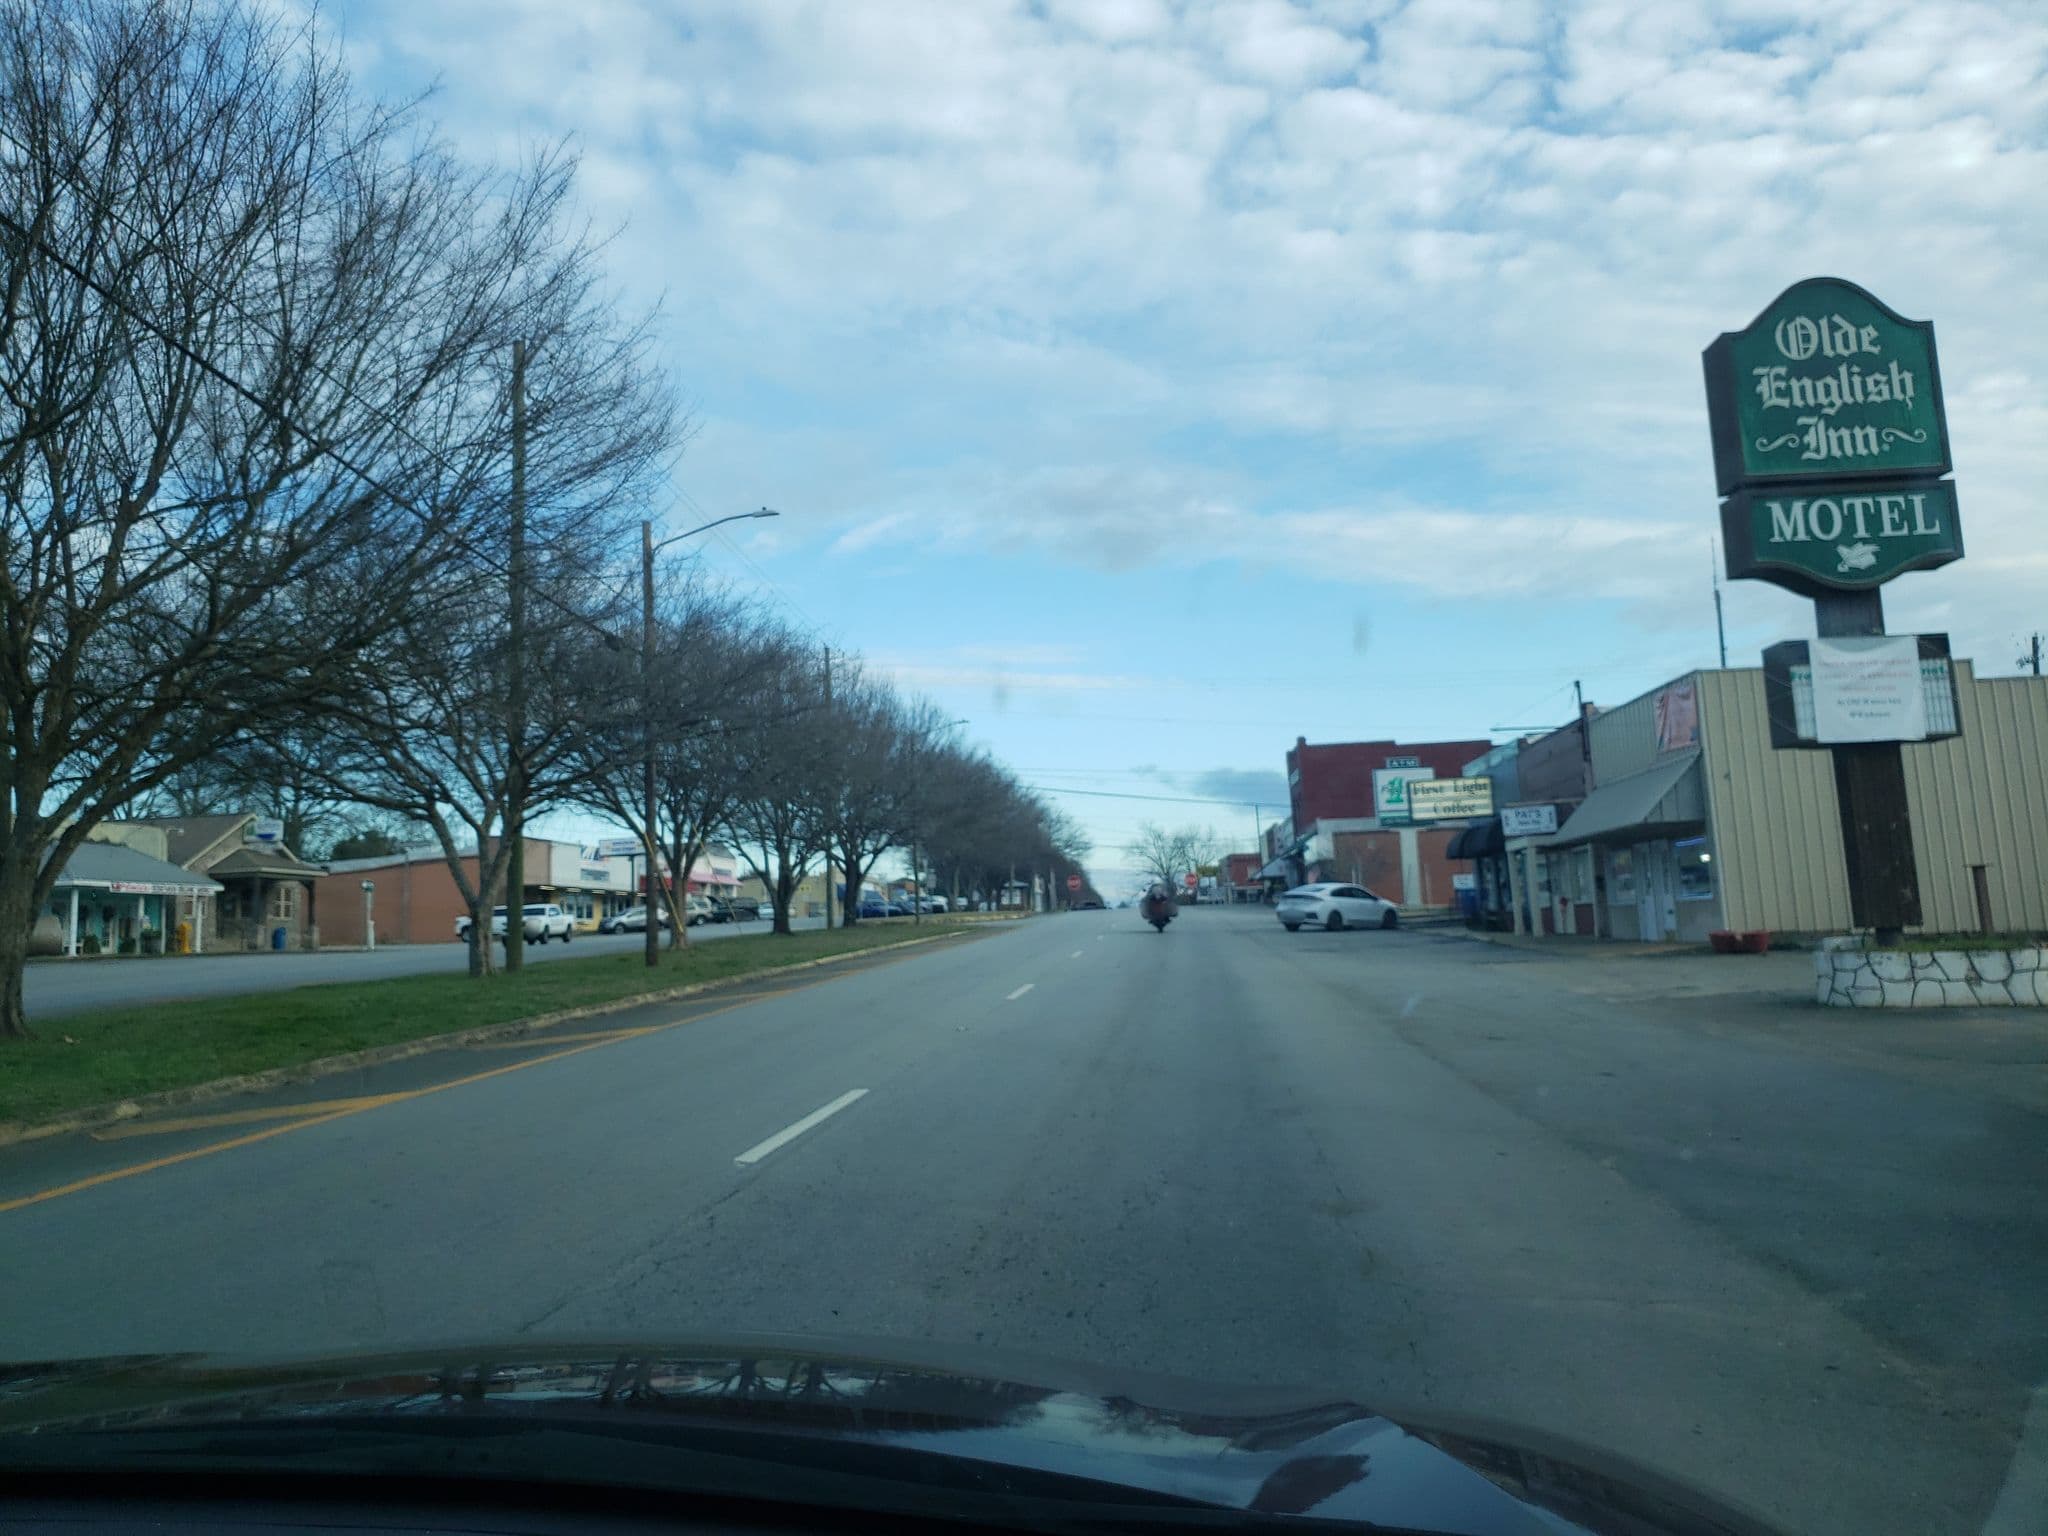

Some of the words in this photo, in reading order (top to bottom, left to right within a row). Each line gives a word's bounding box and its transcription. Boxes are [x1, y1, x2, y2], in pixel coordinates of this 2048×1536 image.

[1775, 313, 1881, 360] Olde
[1753, 360, 1915, 415] English
[1797, 416, 1880, 460] Inn
[1766, 494, 1941, 542] MOTEL
[1413, 782, 1443, 795] First
[1454, 777, 1489, 797] Light
[1433, 802, 1476, 814] Coffee
